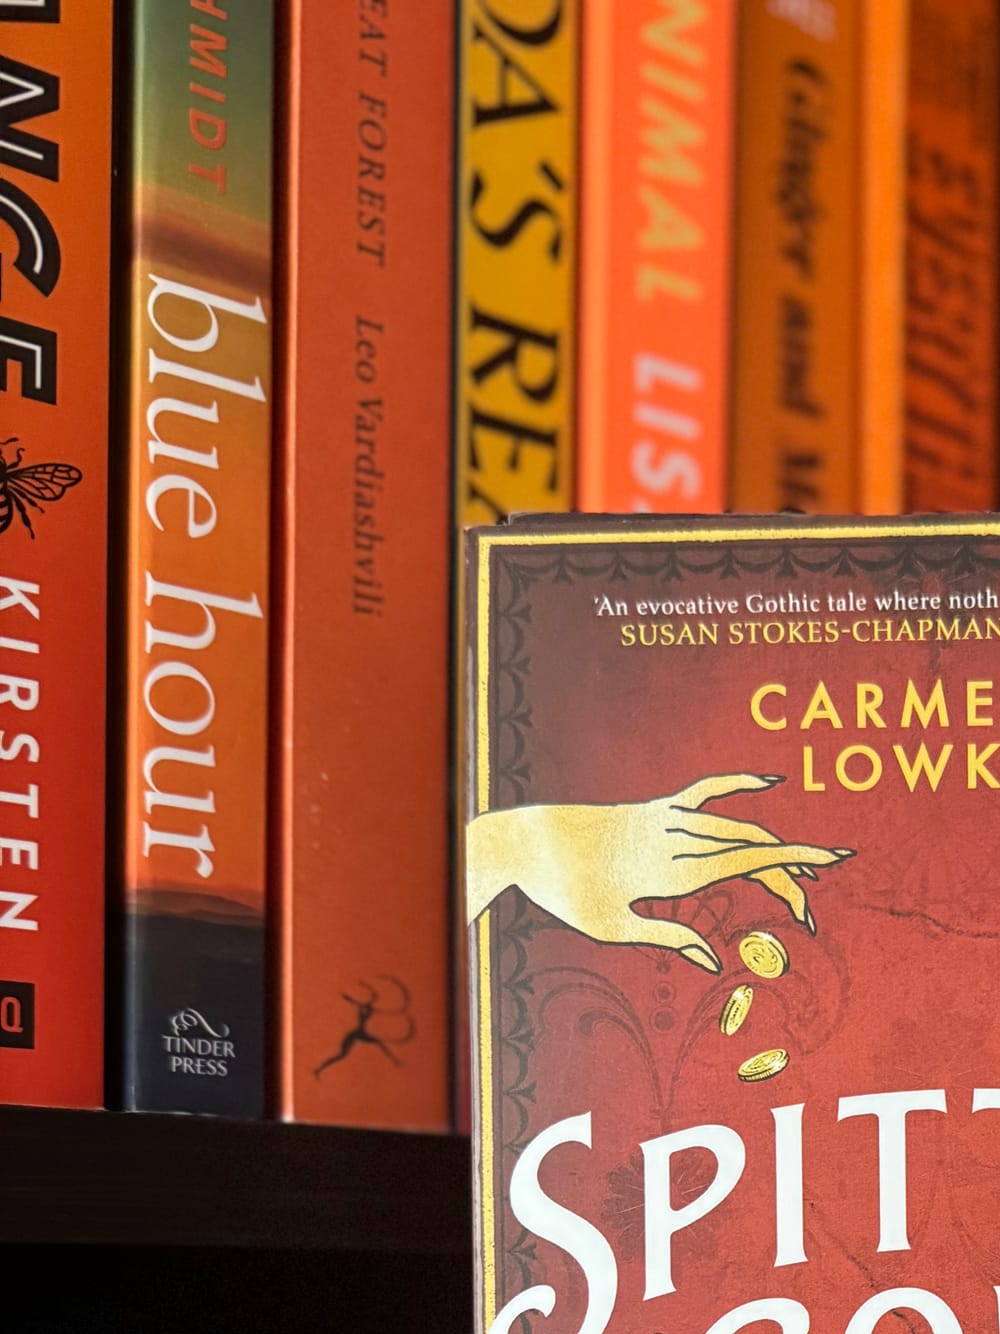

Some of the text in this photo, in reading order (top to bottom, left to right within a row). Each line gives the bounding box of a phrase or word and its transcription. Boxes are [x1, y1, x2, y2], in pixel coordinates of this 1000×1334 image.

[354, 90, 388, 267] FOREST
[353, 316, 386, 619] Leo Vardiashvili
[630, 352, 702, 511] LIS
[143, 273, 267, 878] blue hour
[621, 621, 719, 646] SUSAN
[636, 594, 739, 616] evocative
[746, 592, 820, 615] Gothic
[828, 589, 867, 613] tale
[875, 588, 941, 612] where
[0, 576, 40, 931] KIRSTEN
[162, 1034, 236, 1058] TINDER
[171, 1054, 228, 1077] PRESS
